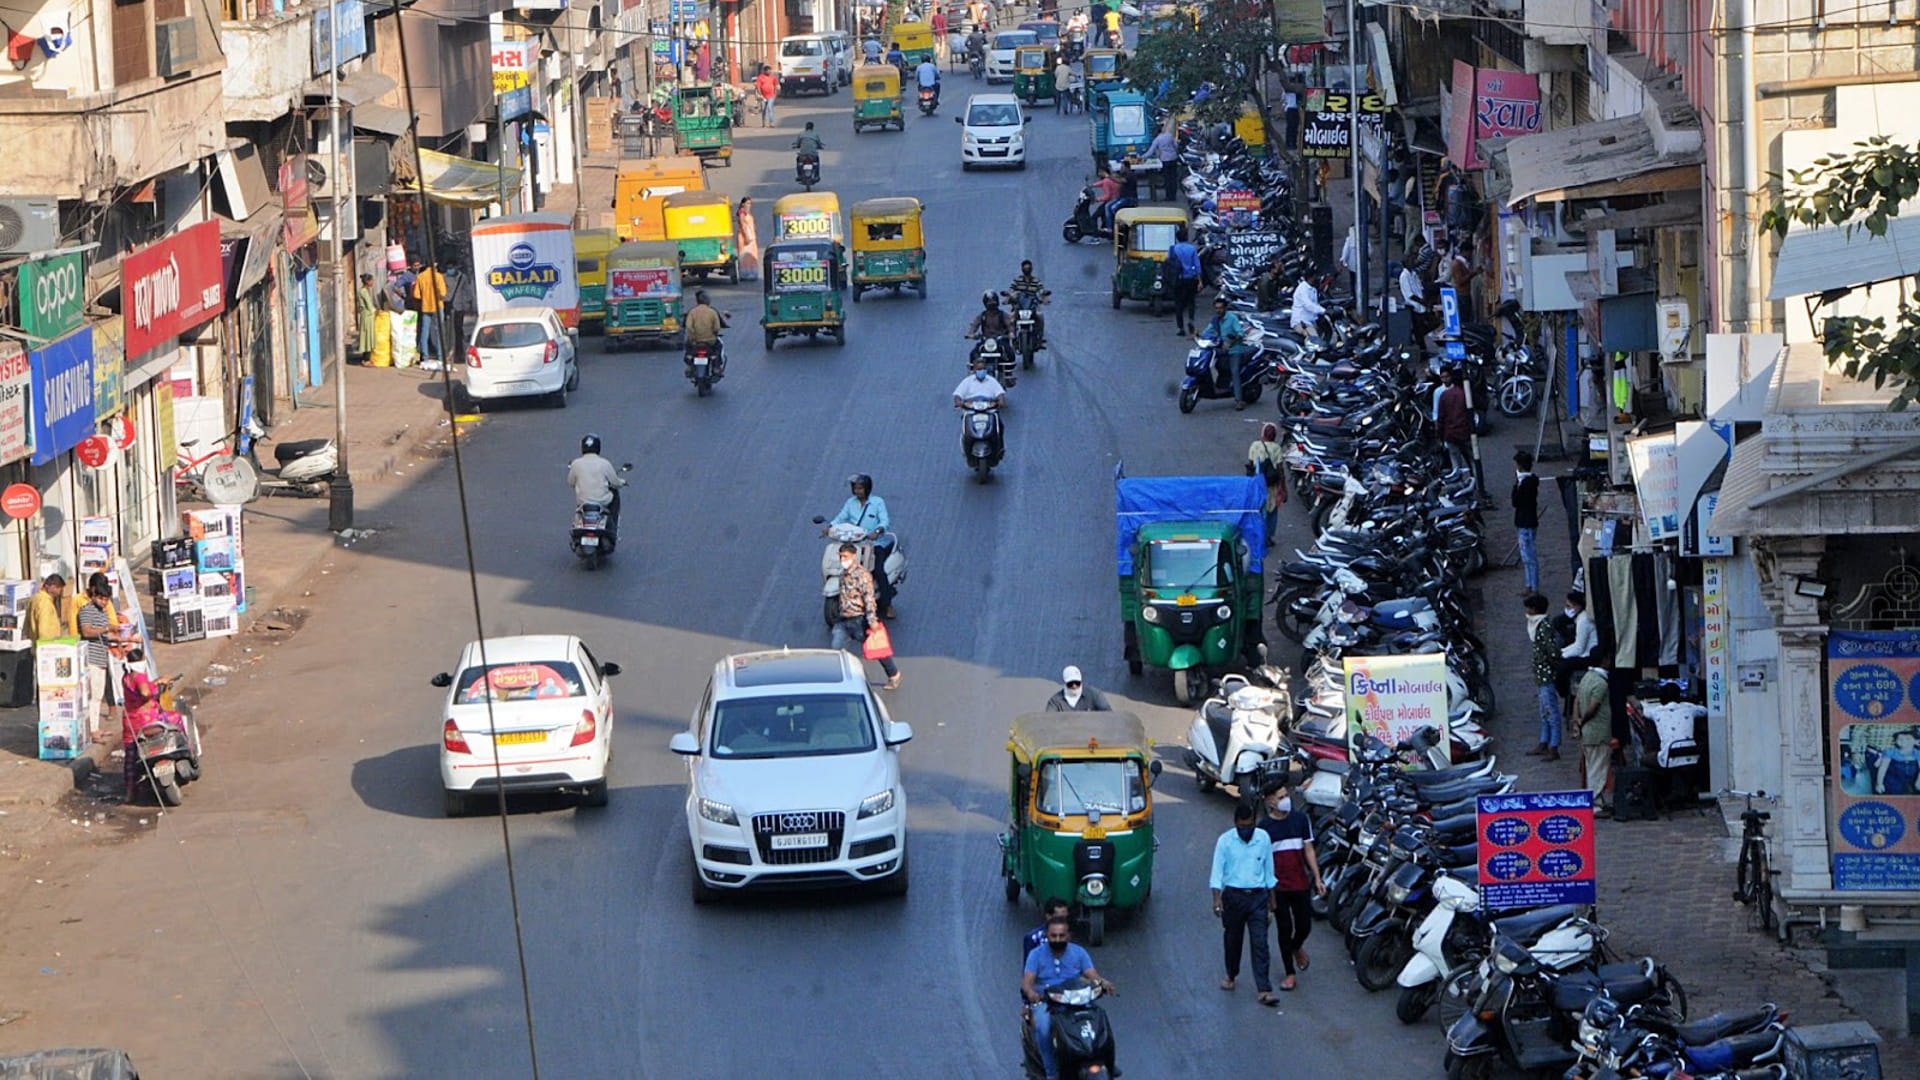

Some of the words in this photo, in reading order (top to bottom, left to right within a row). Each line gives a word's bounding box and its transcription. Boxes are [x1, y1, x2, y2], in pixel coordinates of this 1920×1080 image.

[788, 219, 828, 234] 3000
[490, 268, 556, 286] BALAJI
[780, 267, 825, 284] 3000
[506, 283, 543, 298] WAFERS
[1443, 295, 1456, 328] P
[44, 359, 91, 429] SAMSUNG
